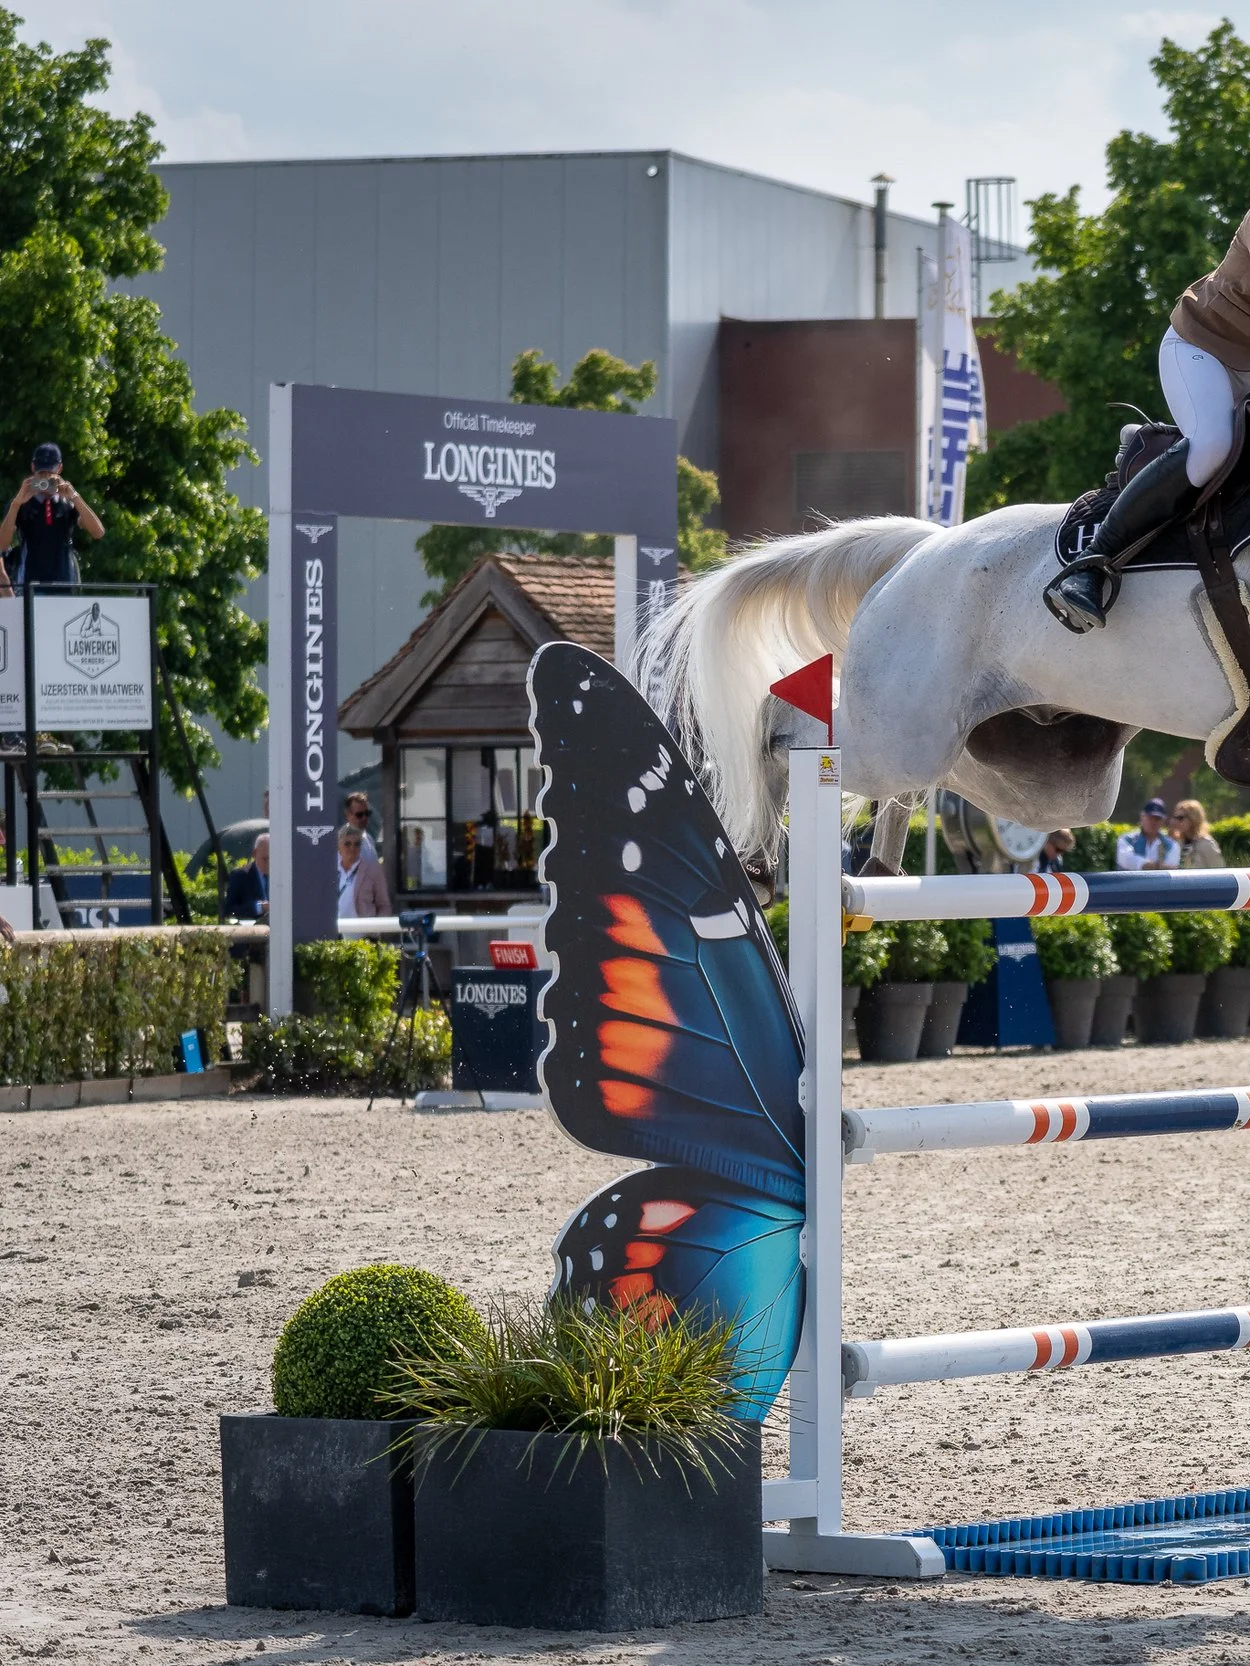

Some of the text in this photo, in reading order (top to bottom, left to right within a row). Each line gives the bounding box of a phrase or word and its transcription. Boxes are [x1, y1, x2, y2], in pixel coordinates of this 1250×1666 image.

[443, 411, 537, 438] Official Timekeeper
[424, 441, 557, 489] LONGINES
[68, 640, 117, 656] LASWERKEN
[40, 683, 145, 697] IJZERSTERK IN MAATWERK
[305, 557, 324, 812] LONGINES
[494, 948, 529, 965] FINISH
[456, 984, 527, 1005] LONGINES
